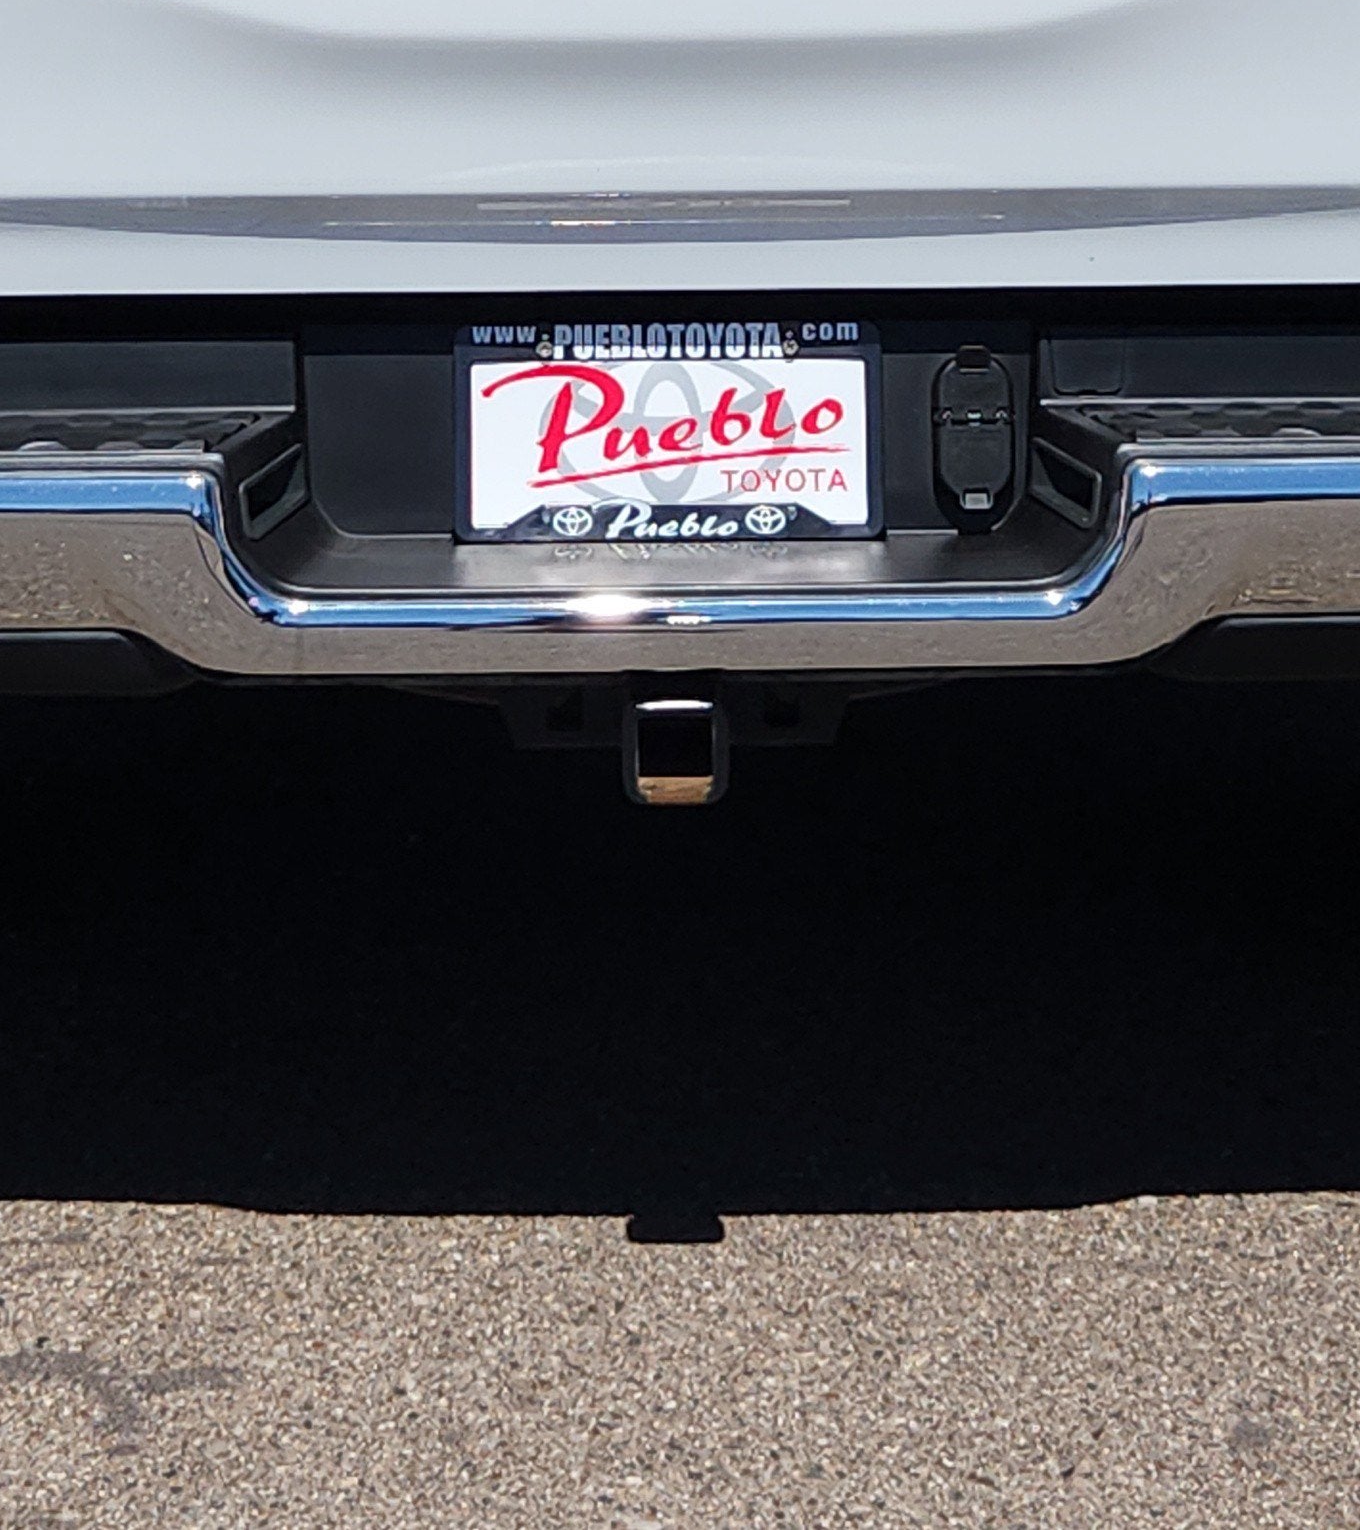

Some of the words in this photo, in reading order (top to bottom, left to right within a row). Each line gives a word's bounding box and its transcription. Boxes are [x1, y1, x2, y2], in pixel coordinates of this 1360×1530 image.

[481, 364, 845, 474] Pueblo
[720, 469, 849, 493] TOYOTA
[605, 497, 740, 540] Pueblo
